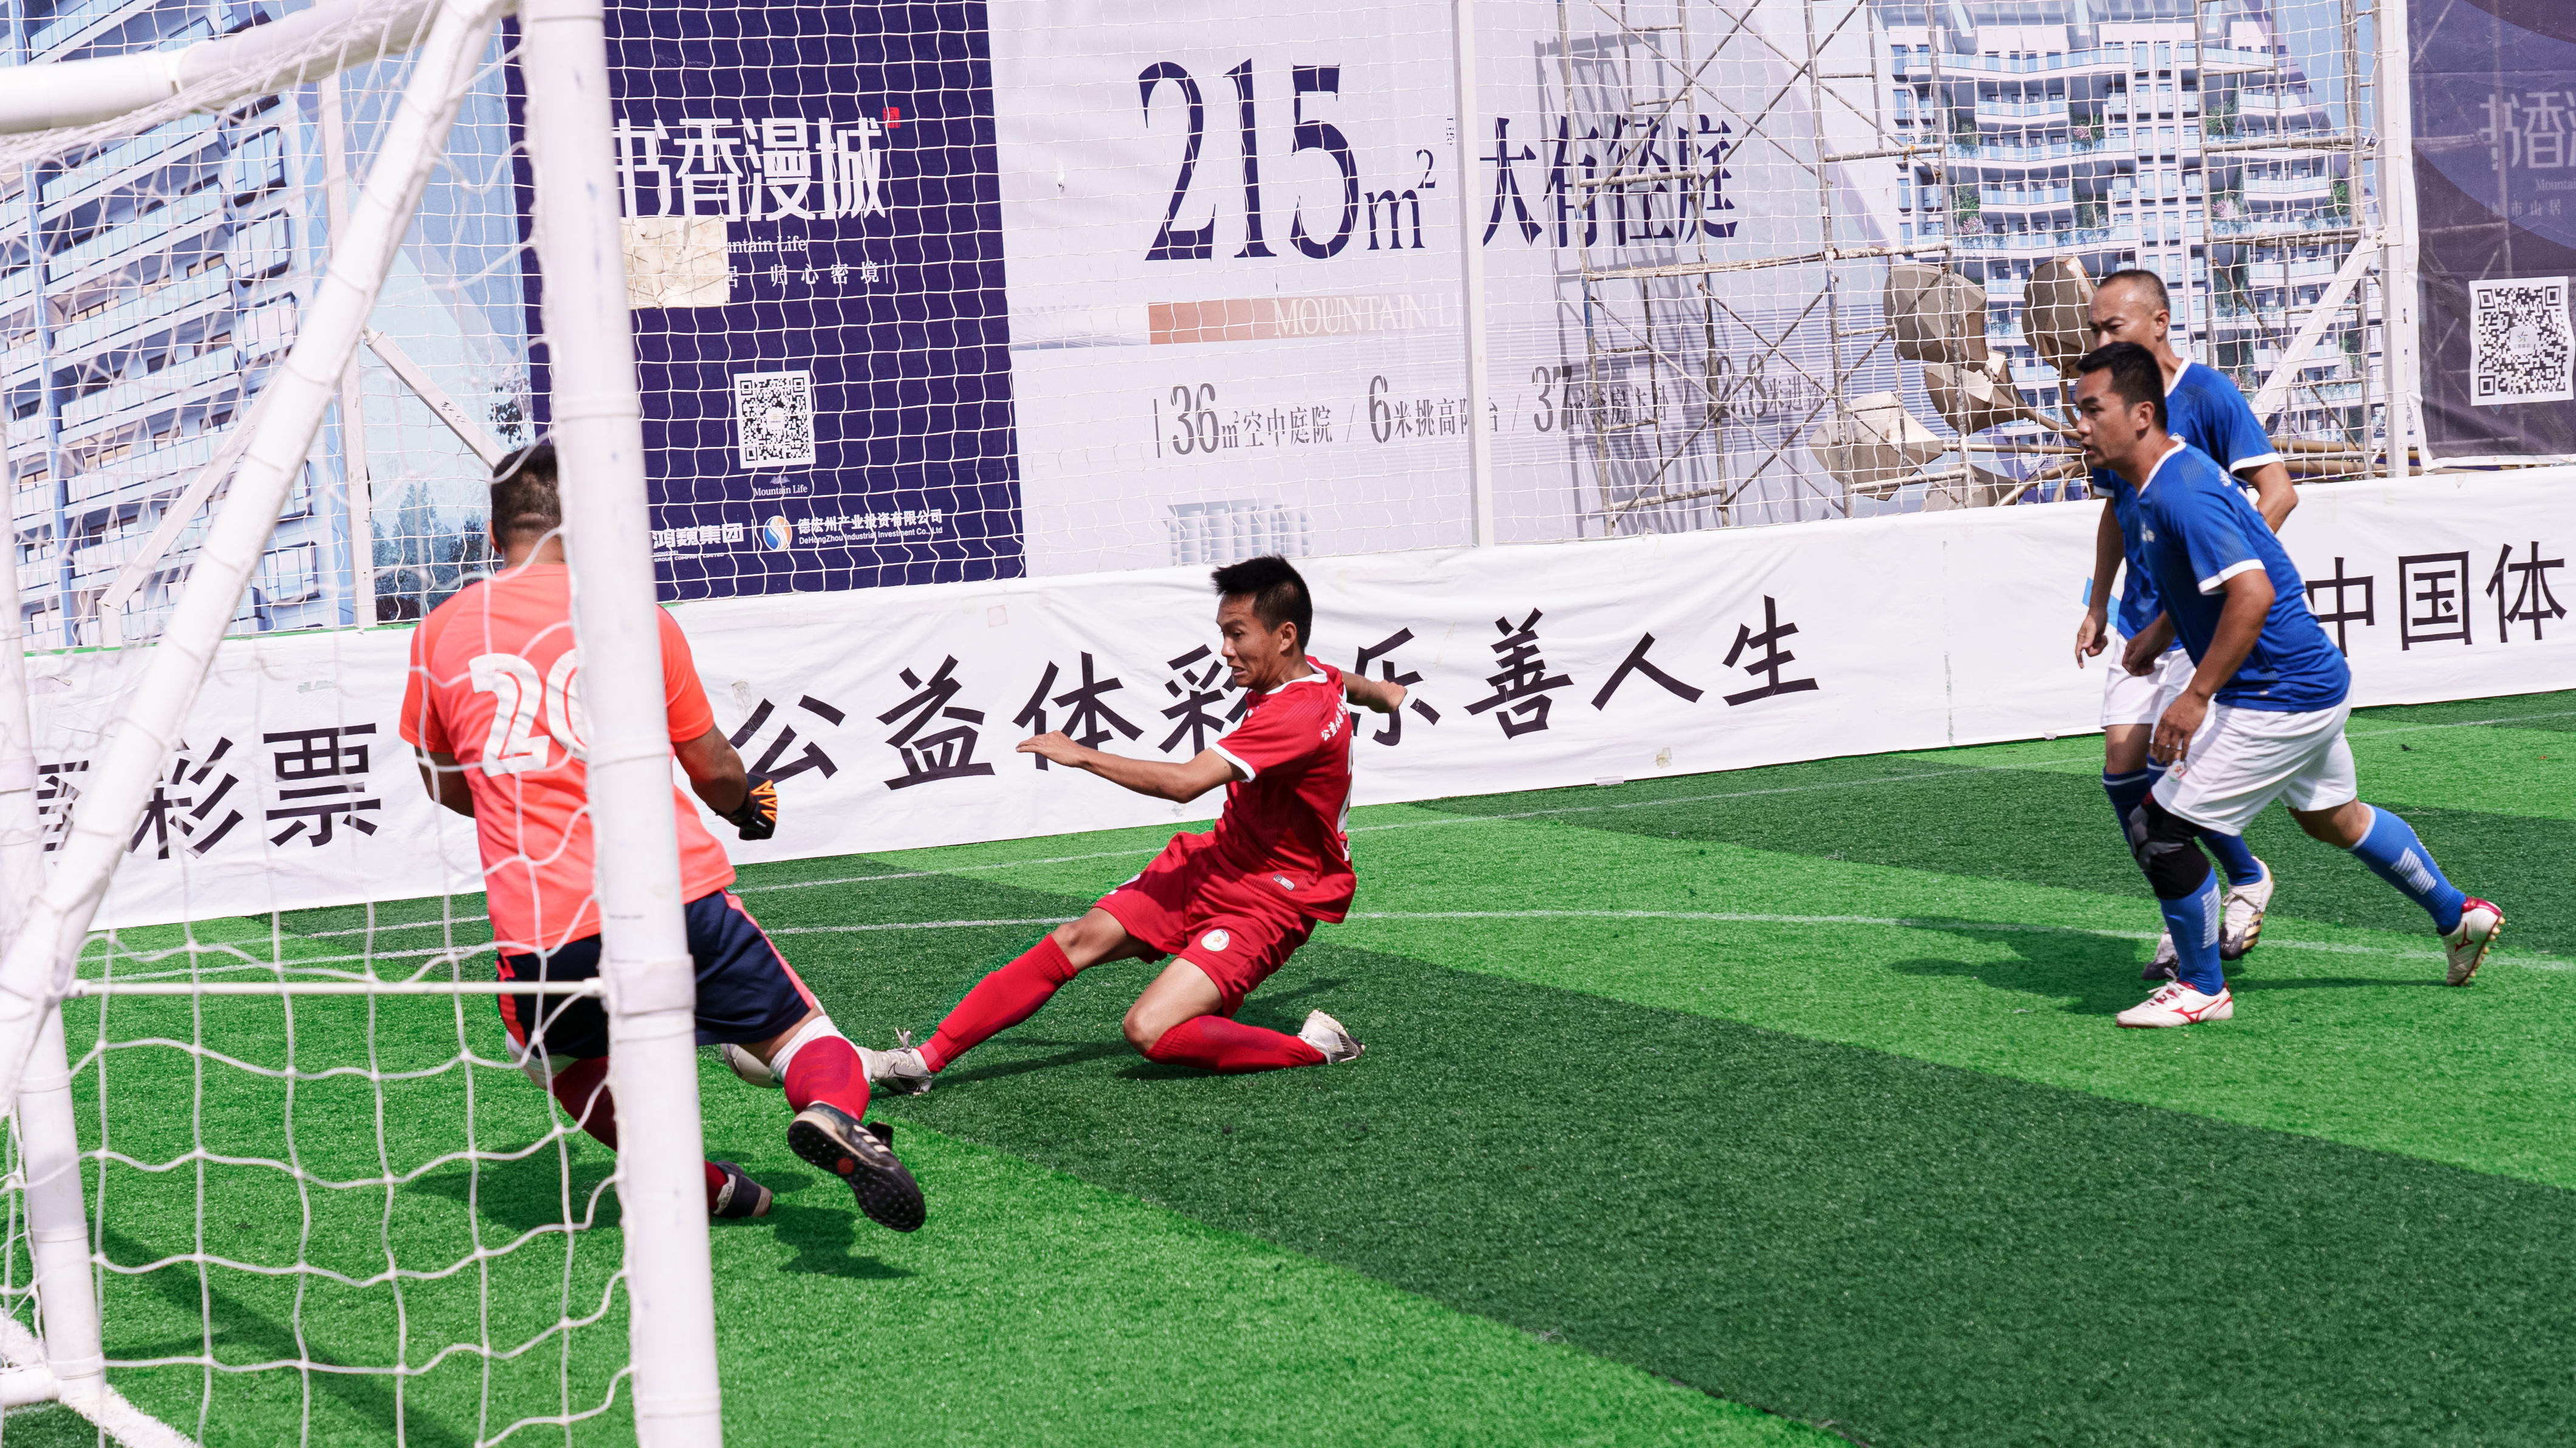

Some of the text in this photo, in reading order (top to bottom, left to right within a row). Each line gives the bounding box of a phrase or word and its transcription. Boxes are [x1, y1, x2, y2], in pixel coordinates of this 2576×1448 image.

[2479, 92, 2576, 171] 书香
[612, 117, 886, 222] 书香漫城
[1479, 114, 1738, 248] 大有径庭
[777, 235, 807, 251] Life
[770, 261, 880, 287] 归心密境
[1271, 292, 1496, 336] MOUNTAIN LIE
[753, 484, 807, 496] Mountain Life
[798, 508, 943, 534] 德宏州产业投资有限公司
[878, 528, 916, 538] Investment
[2306, 541, 2567, 658] 中国体
